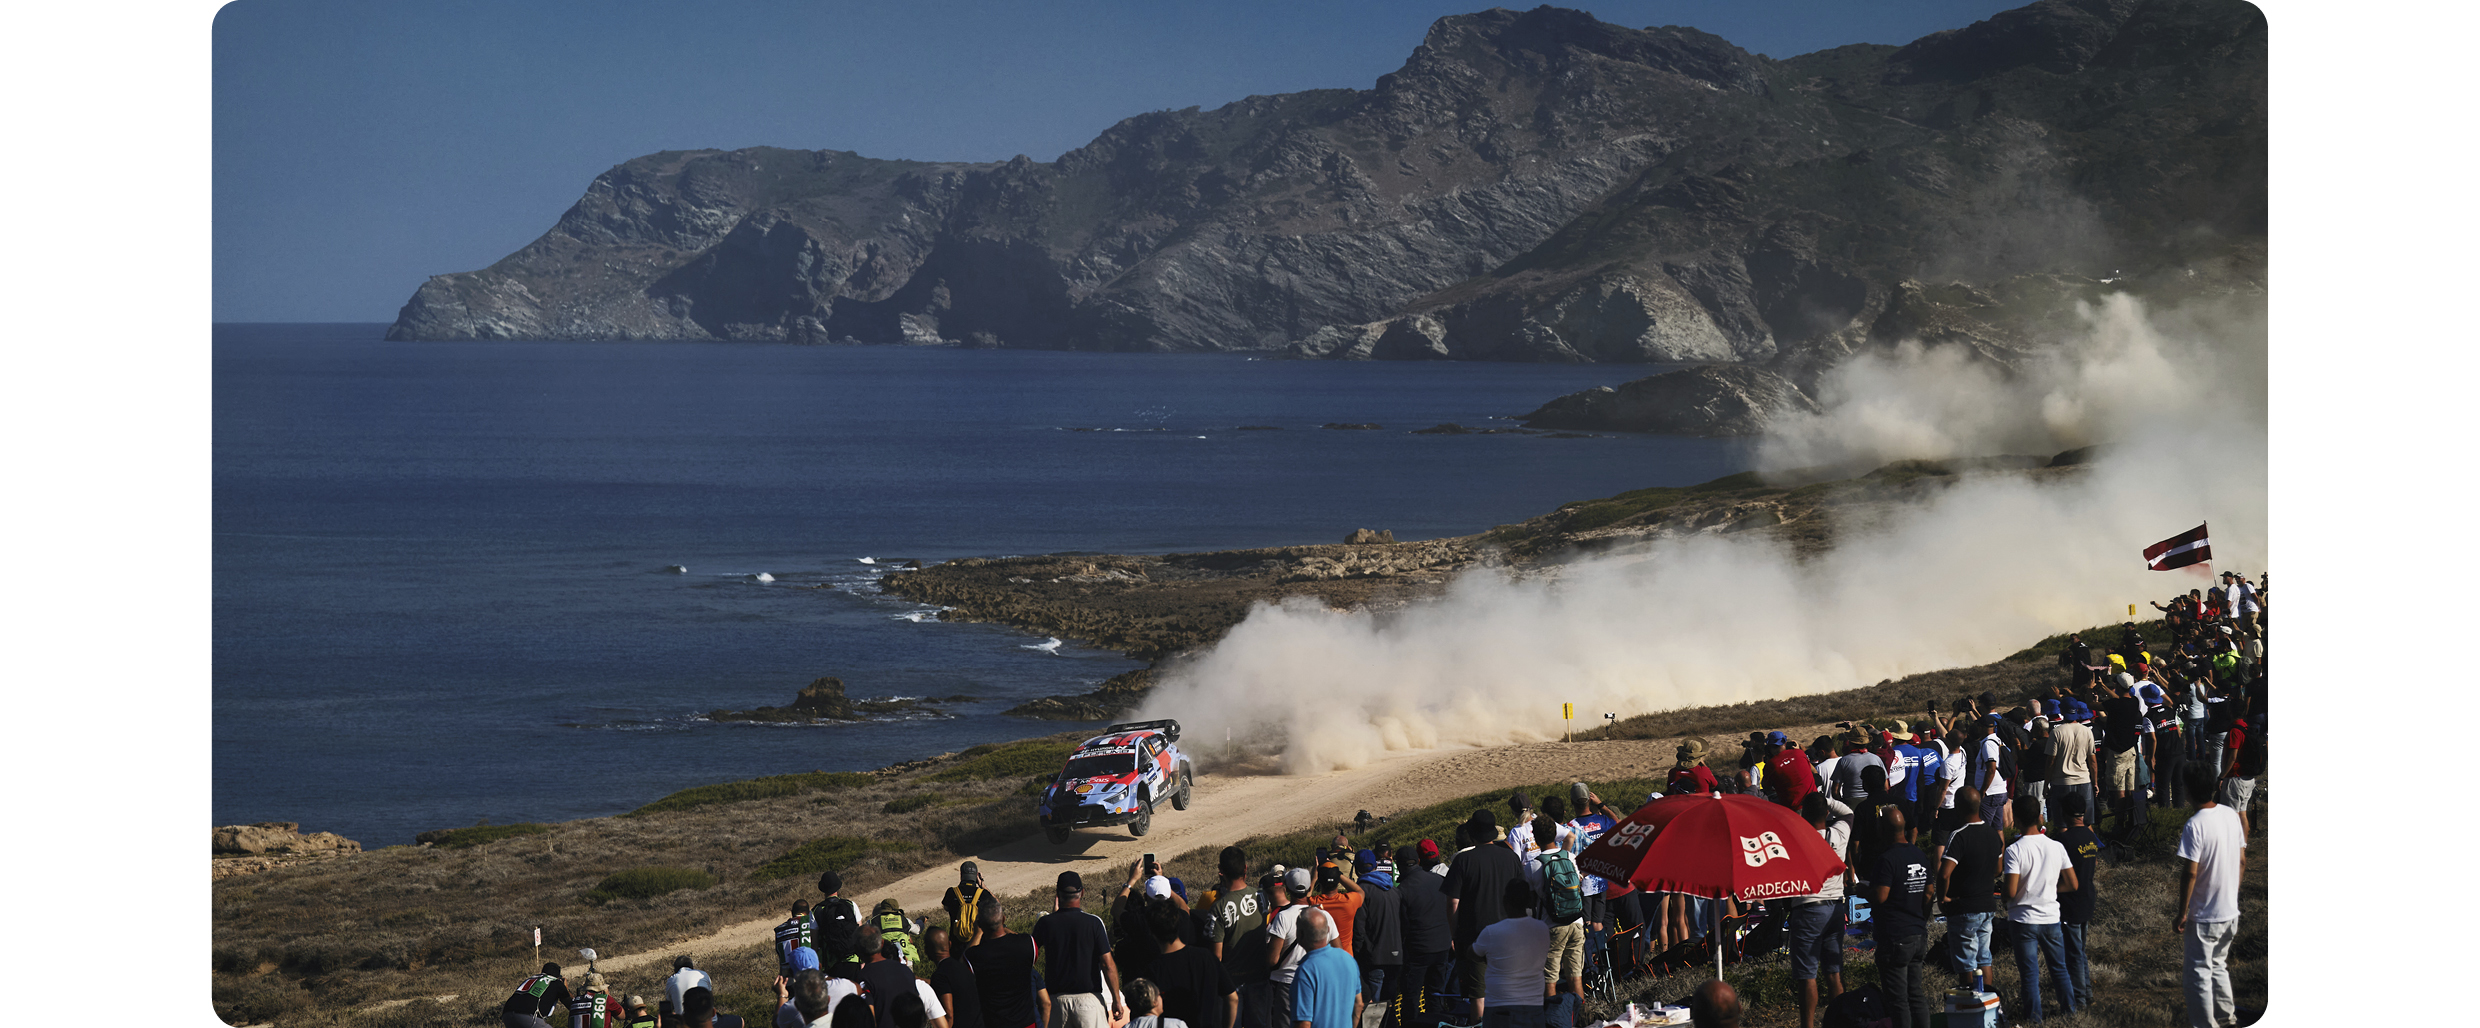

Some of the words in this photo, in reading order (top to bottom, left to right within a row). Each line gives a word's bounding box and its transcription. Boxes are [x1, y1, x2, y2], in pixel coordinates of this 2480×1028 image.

[1580, 857, 1625, 881] SARDEGNA
[1743, 880, 1812, 898] SARDEGNA
[801, 922, 812, 944] 219
[593, 997, 606, 1020] 260
